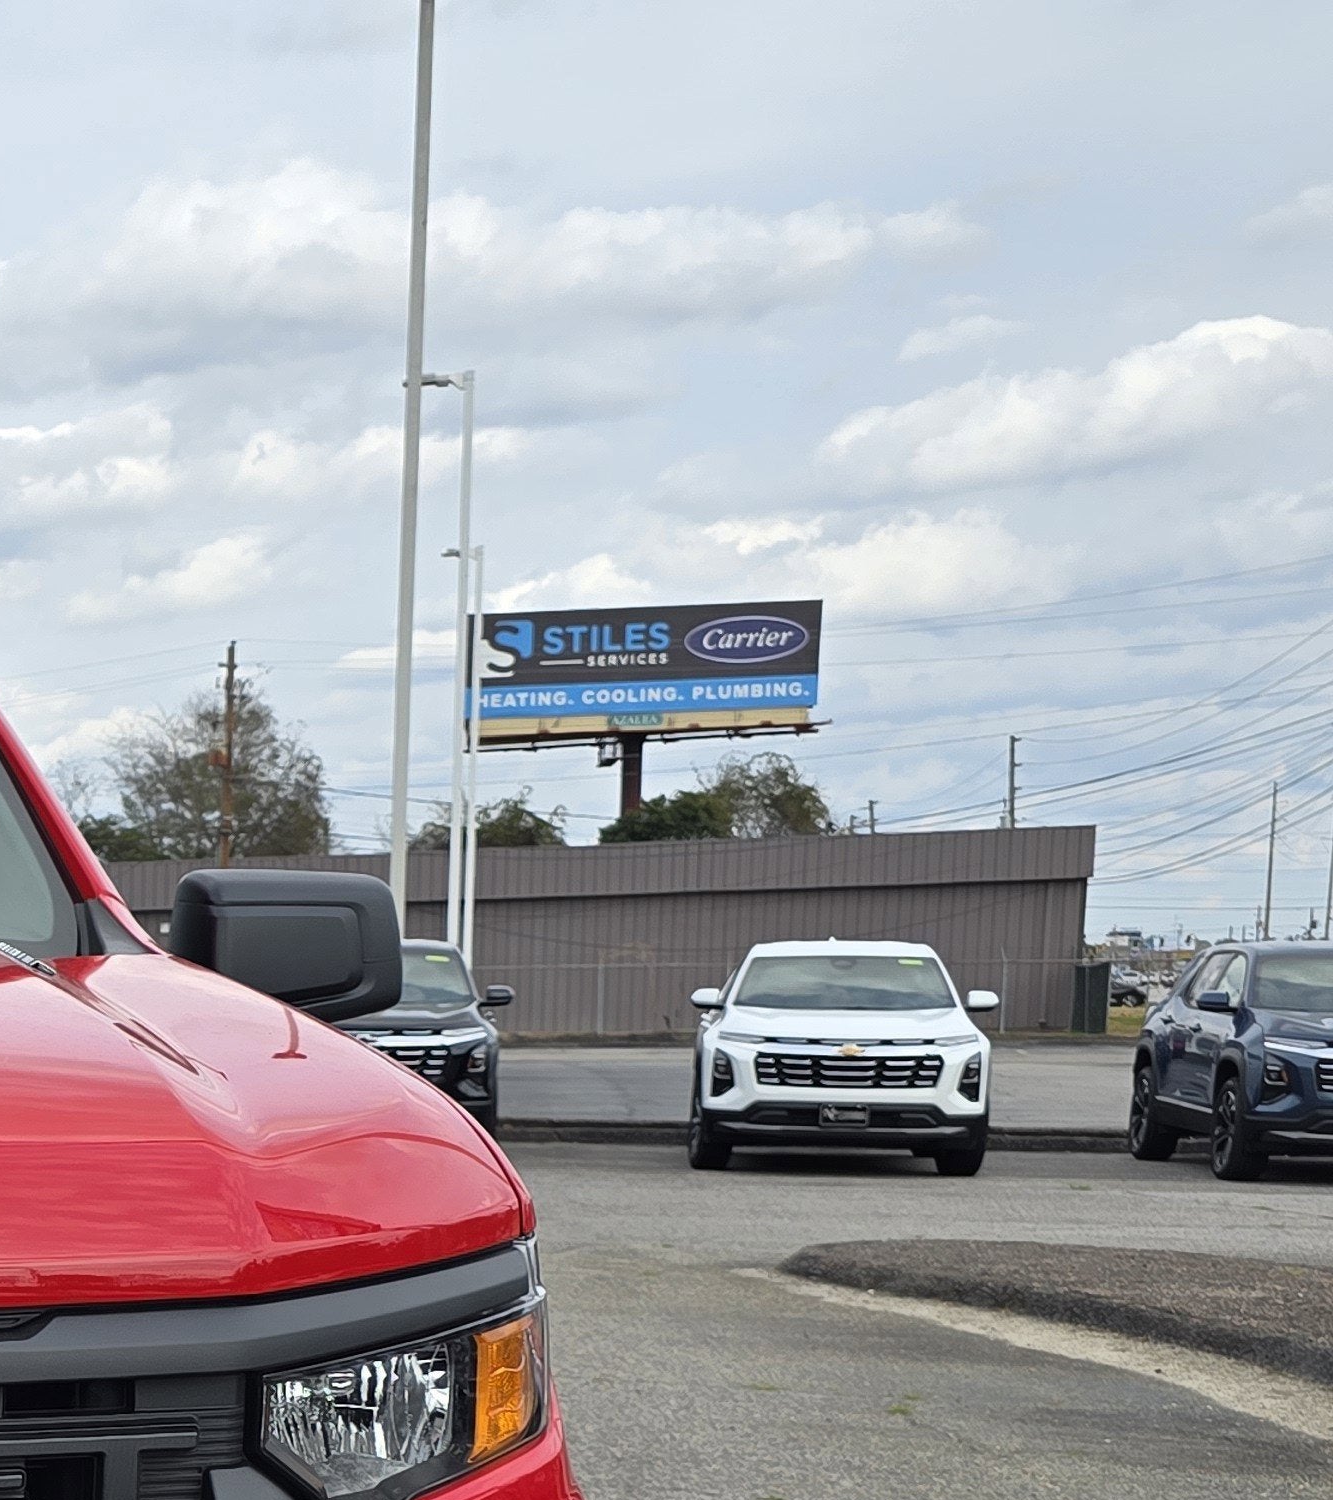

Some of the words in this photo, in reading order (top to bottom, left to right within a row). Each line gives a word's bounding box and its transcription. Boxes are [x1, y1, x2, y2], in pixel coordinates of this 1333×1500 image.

[543, 622, 670, 656] STILES
[701, 626, 795, 651] Carrier
[586, 652, 669, 667] SERVICES
[479, 691, 575, 708] HEATING.
[581, 686, 683, 705] COOLING.
[692, 682, 809, 701] PLUMBING.
